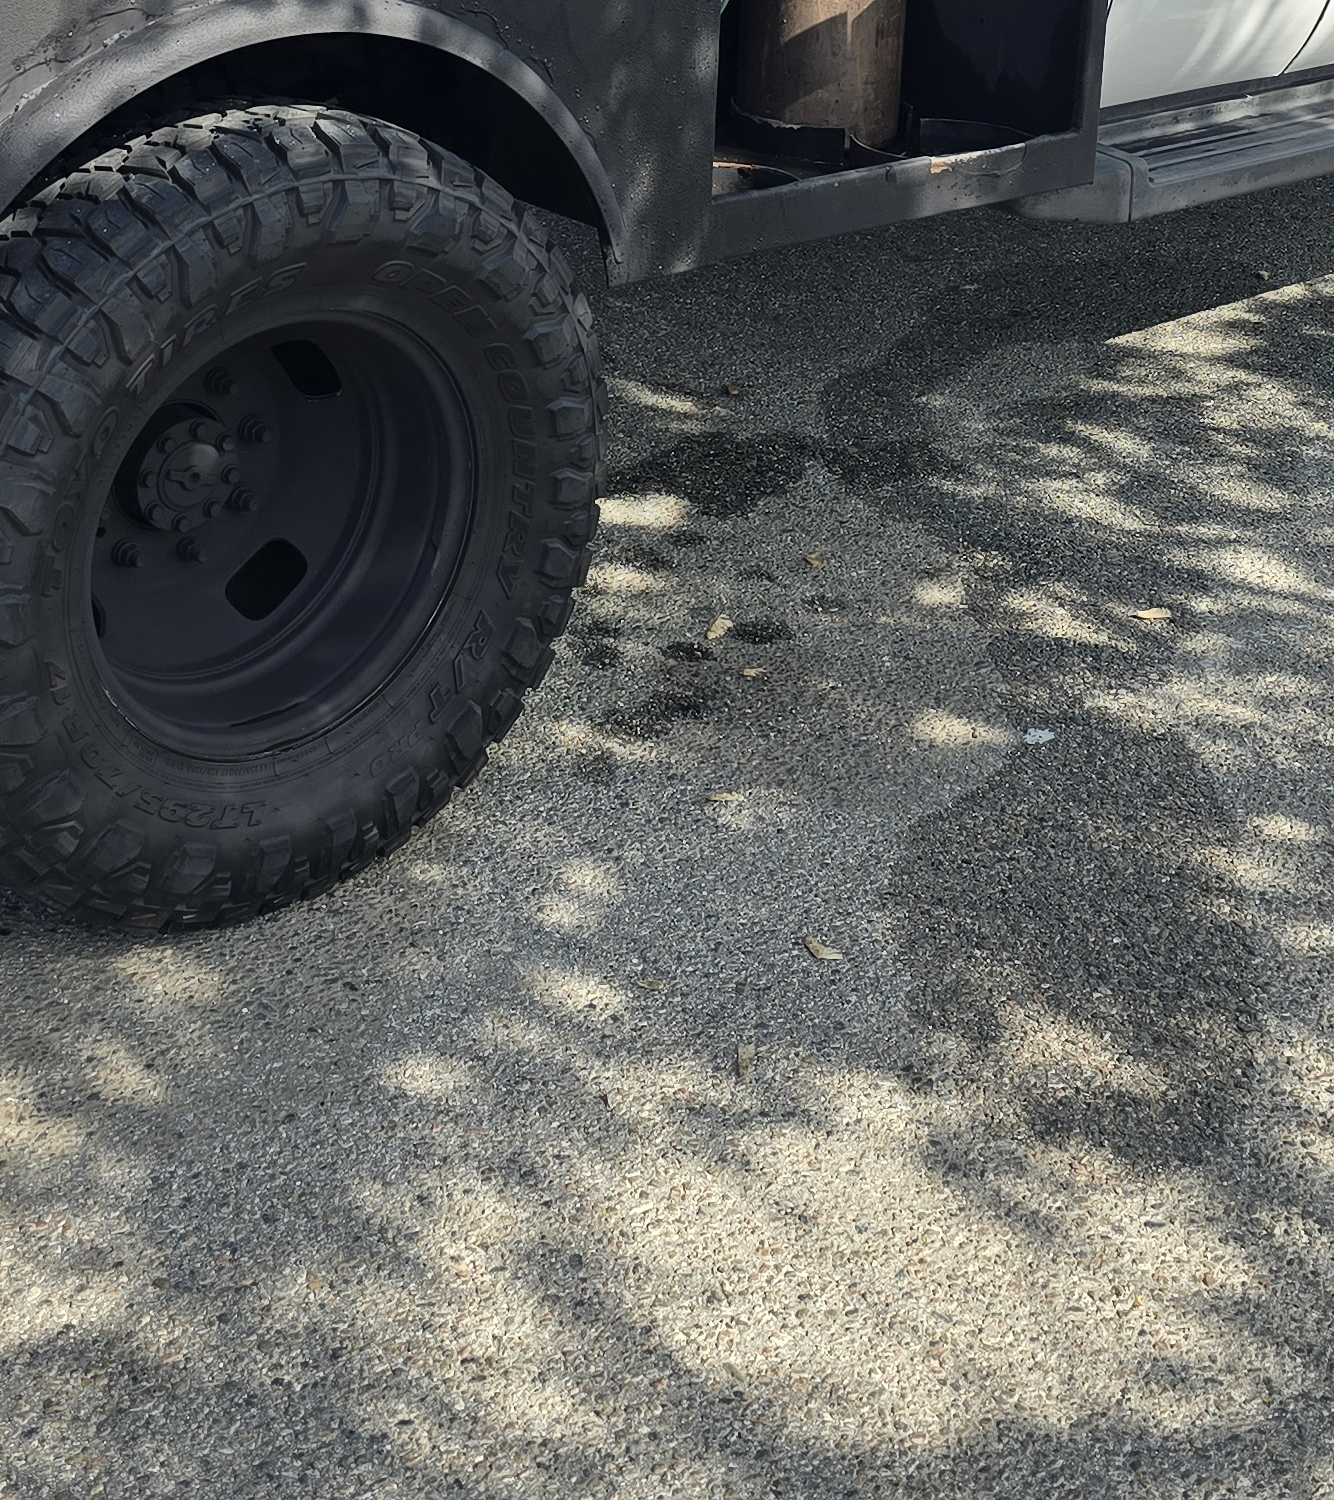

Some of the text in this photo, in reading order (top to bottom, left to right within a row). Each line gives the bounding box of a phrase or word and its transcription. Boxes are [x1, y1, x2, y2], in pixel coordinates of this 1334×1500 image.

[124, 261, 308, 396] TIRES
[372, 259, 498, 339] OPEN
[484, 342, 538, 601] COUNTRY
[429, 608, 498, 726] R/T
